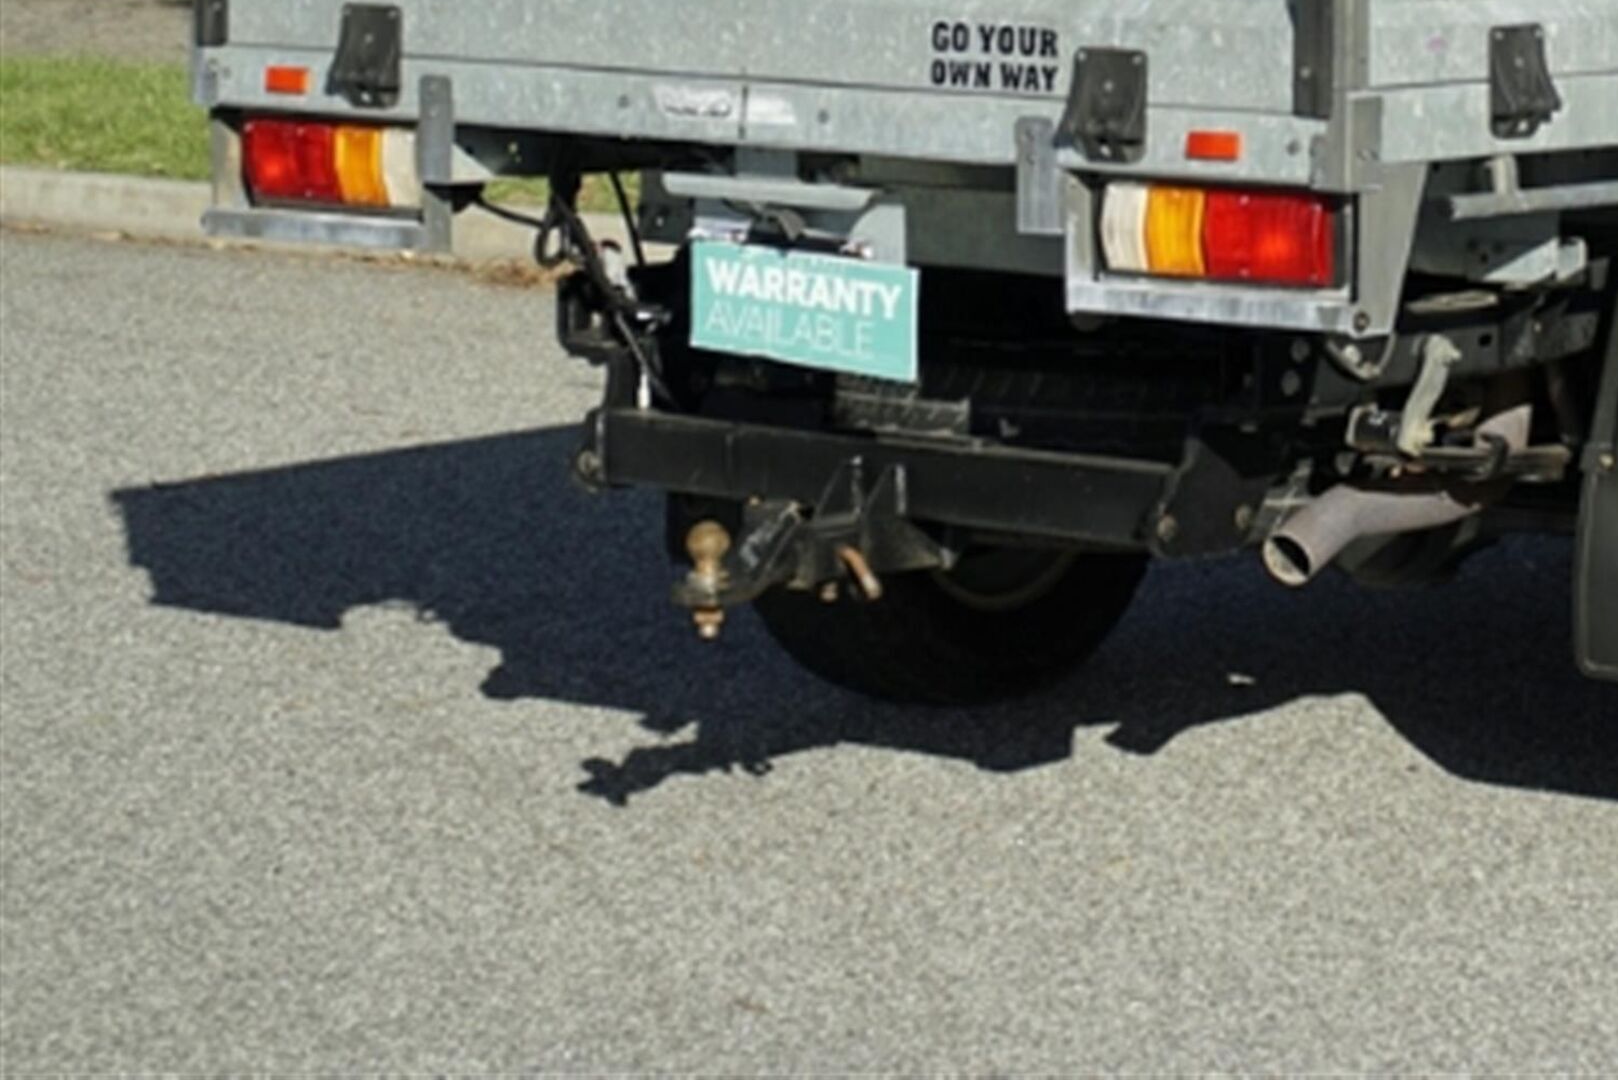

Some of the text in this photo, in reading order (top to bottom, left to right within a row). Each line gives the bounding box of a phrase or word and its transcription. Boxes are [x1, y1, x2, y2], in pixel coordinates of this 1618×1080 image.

[931, 21, 1058, 57] GO YOUR
[931, 59, 1058, 91] OWN WAY
[705, 257, 902, 319] WARRANTY
[705, 299, 875, 358] AVAILABLE
